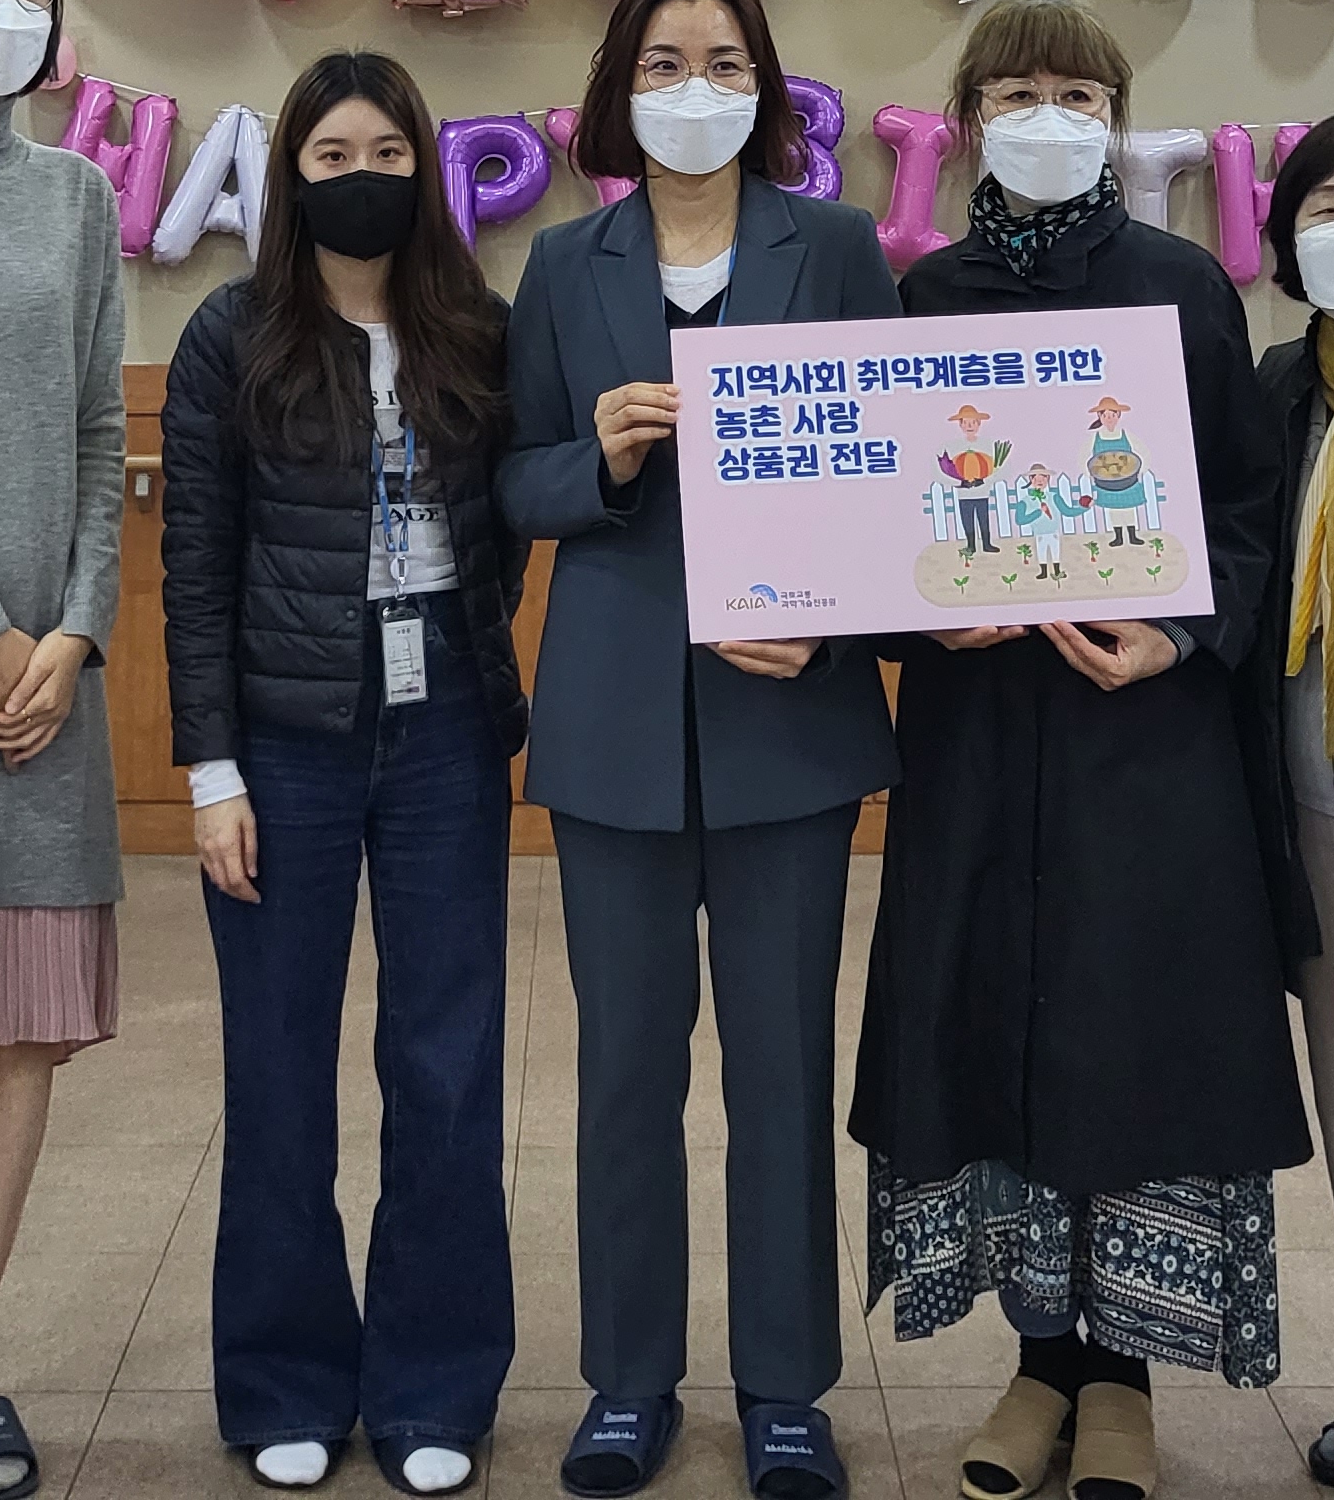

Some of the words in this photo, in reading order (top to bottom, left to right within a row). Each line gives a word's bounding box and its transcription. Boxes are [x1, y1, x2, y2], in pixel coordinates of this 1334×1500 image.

[711, 360, 846, 398] 지역사회
[857, 353, 1025, 392] 취약계층을
[1035, 348, 1103, 383] 위한
[715, 404, 782, 439] 농촌
[793, 401, 860, 435] 사랑
[718, 443, 819, 481] 상품권
[830, 440, 898, 476] 전달
[726, 596, 767, 611] KAIA
